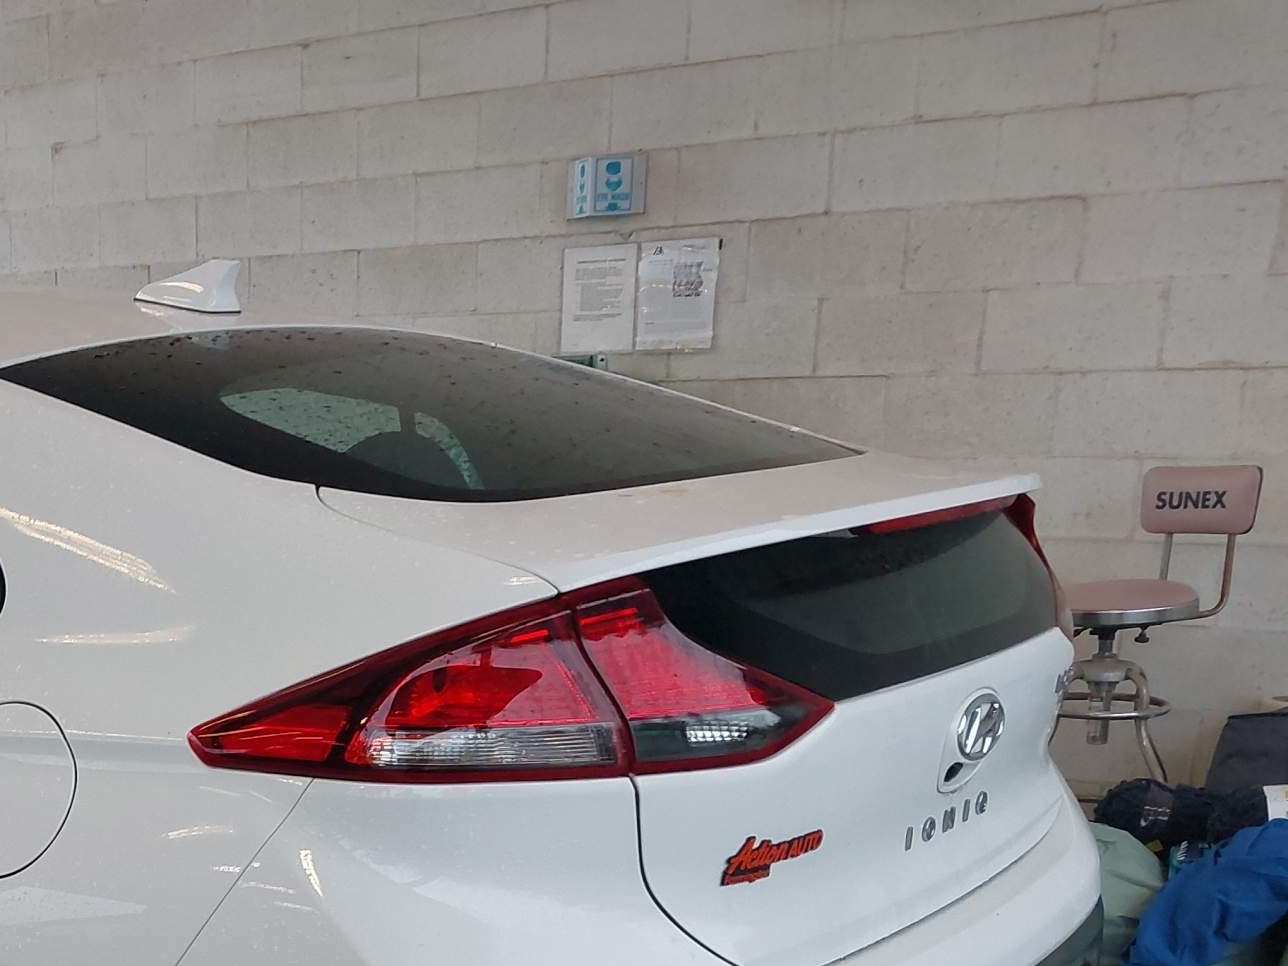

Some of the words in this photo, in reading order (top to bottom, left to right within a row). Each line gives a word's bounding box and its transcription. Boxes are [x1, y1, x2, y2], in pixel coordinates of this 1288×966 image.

[1155, 490, 1227, 509] SUNEX
[904, 790, 988, 852] IONIQ
[725, 836, 791, 875] Action
